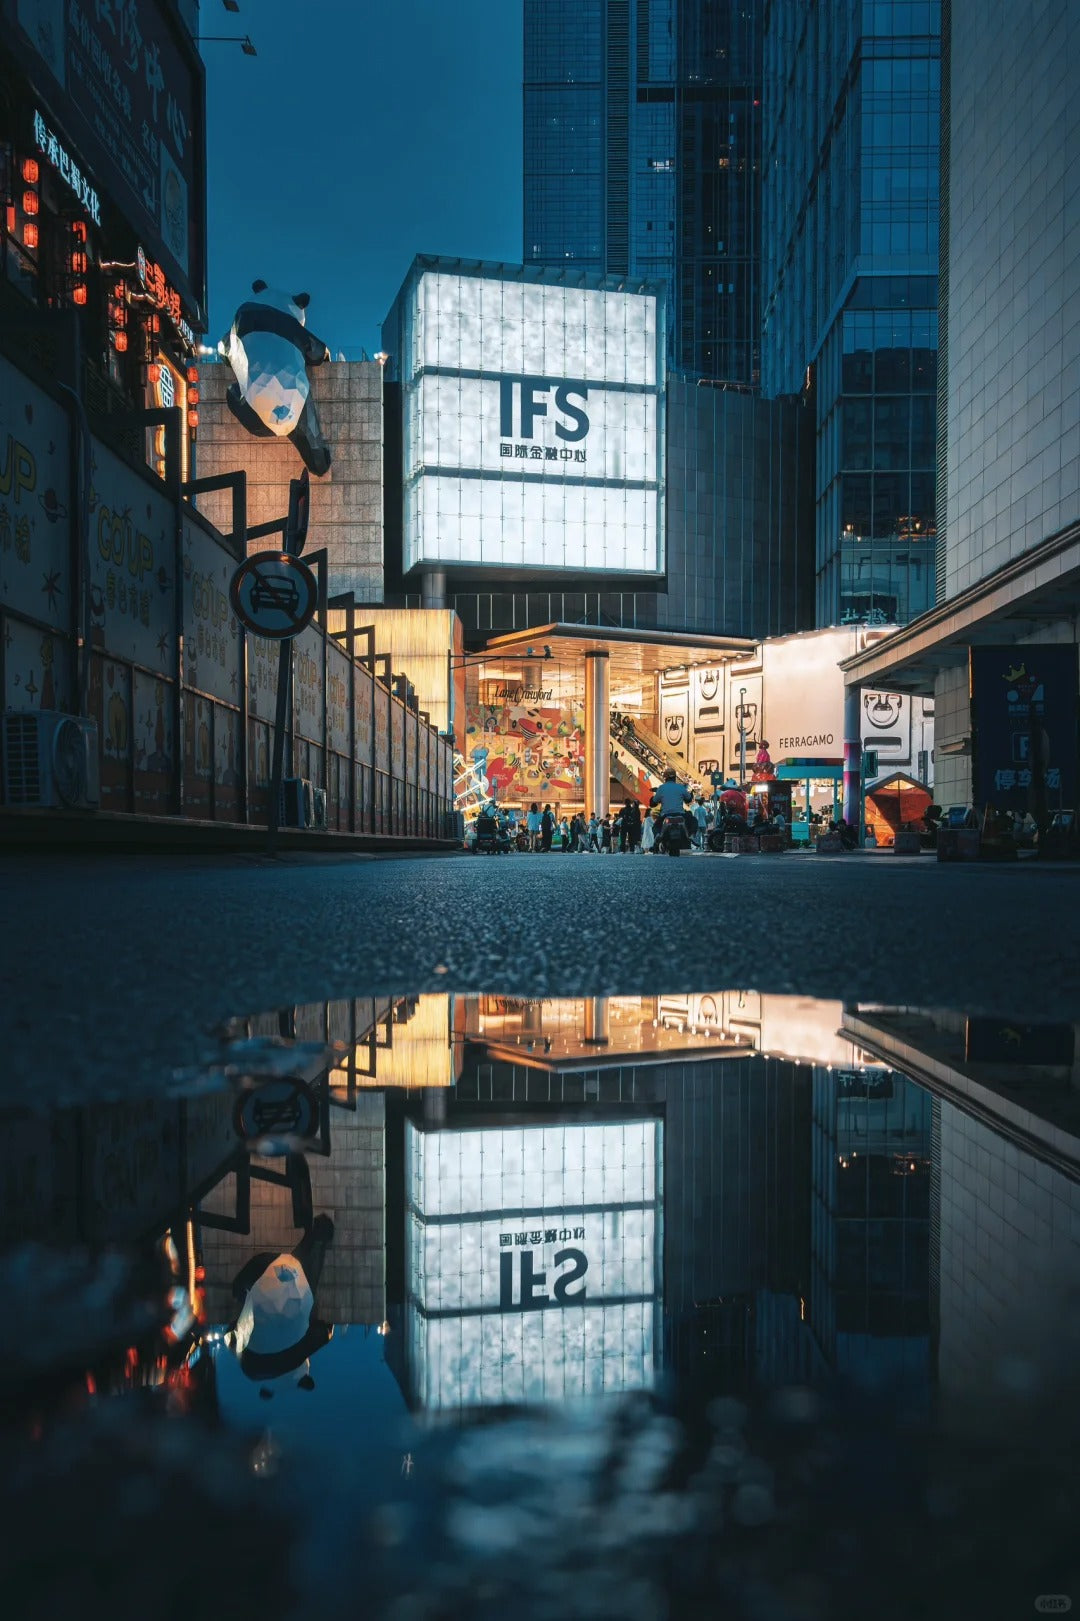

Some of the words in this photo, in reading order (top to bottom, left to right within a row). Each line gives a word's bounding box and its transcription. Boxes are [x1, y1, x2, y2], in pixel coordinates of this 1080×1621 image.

[34, 109, 101, 227] 传承巴蜀文化
[500, 378, 590, 442] IFS
[500, 443, 587, 462] 国际金融中心
[495, 685, 514, 700] Lane
[512, 686, 553, 706] Crawford
[779, 734, 834, 749] FERRAGAMO
